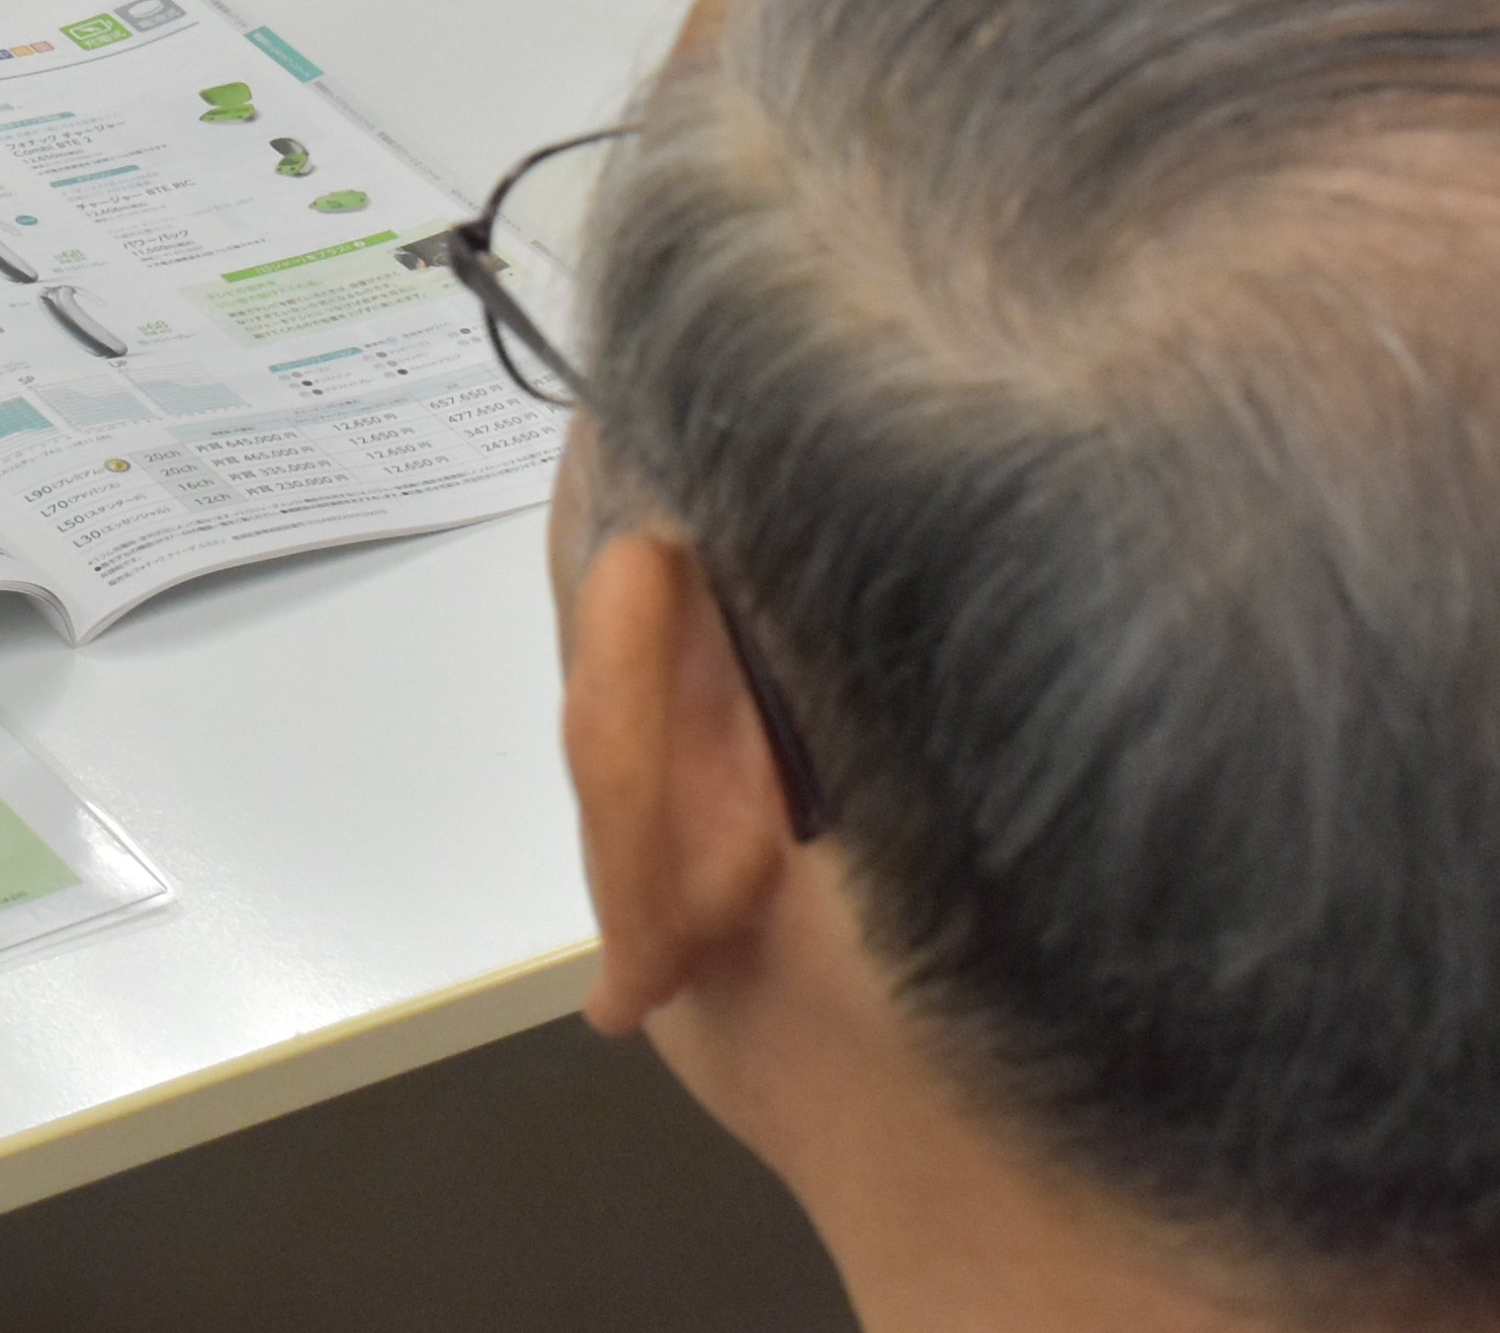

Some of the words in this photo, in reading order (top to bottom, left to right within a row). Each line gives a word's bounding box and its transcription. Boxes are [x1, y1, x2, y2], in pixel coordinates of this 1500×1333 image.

[430, 388, 487, 409] 657,650
[449, 402, 505, 423] 477,650
[333, 416, 382, 433] 12,650
[464, 416, 523, 438] 347,650
[350, 430, 399, 446] 12,650
[482, 430, 541, 453] 242,650
[145, 448, 182, 463] 20ch
[366, 444, 416, 460] 12,650
[161, 463, 198, 478] 20ch
[383, 458, 434, 475] 12,650
[177, 478, 215, 493] 16ch
[194, 492, 232, 506] 12ch
